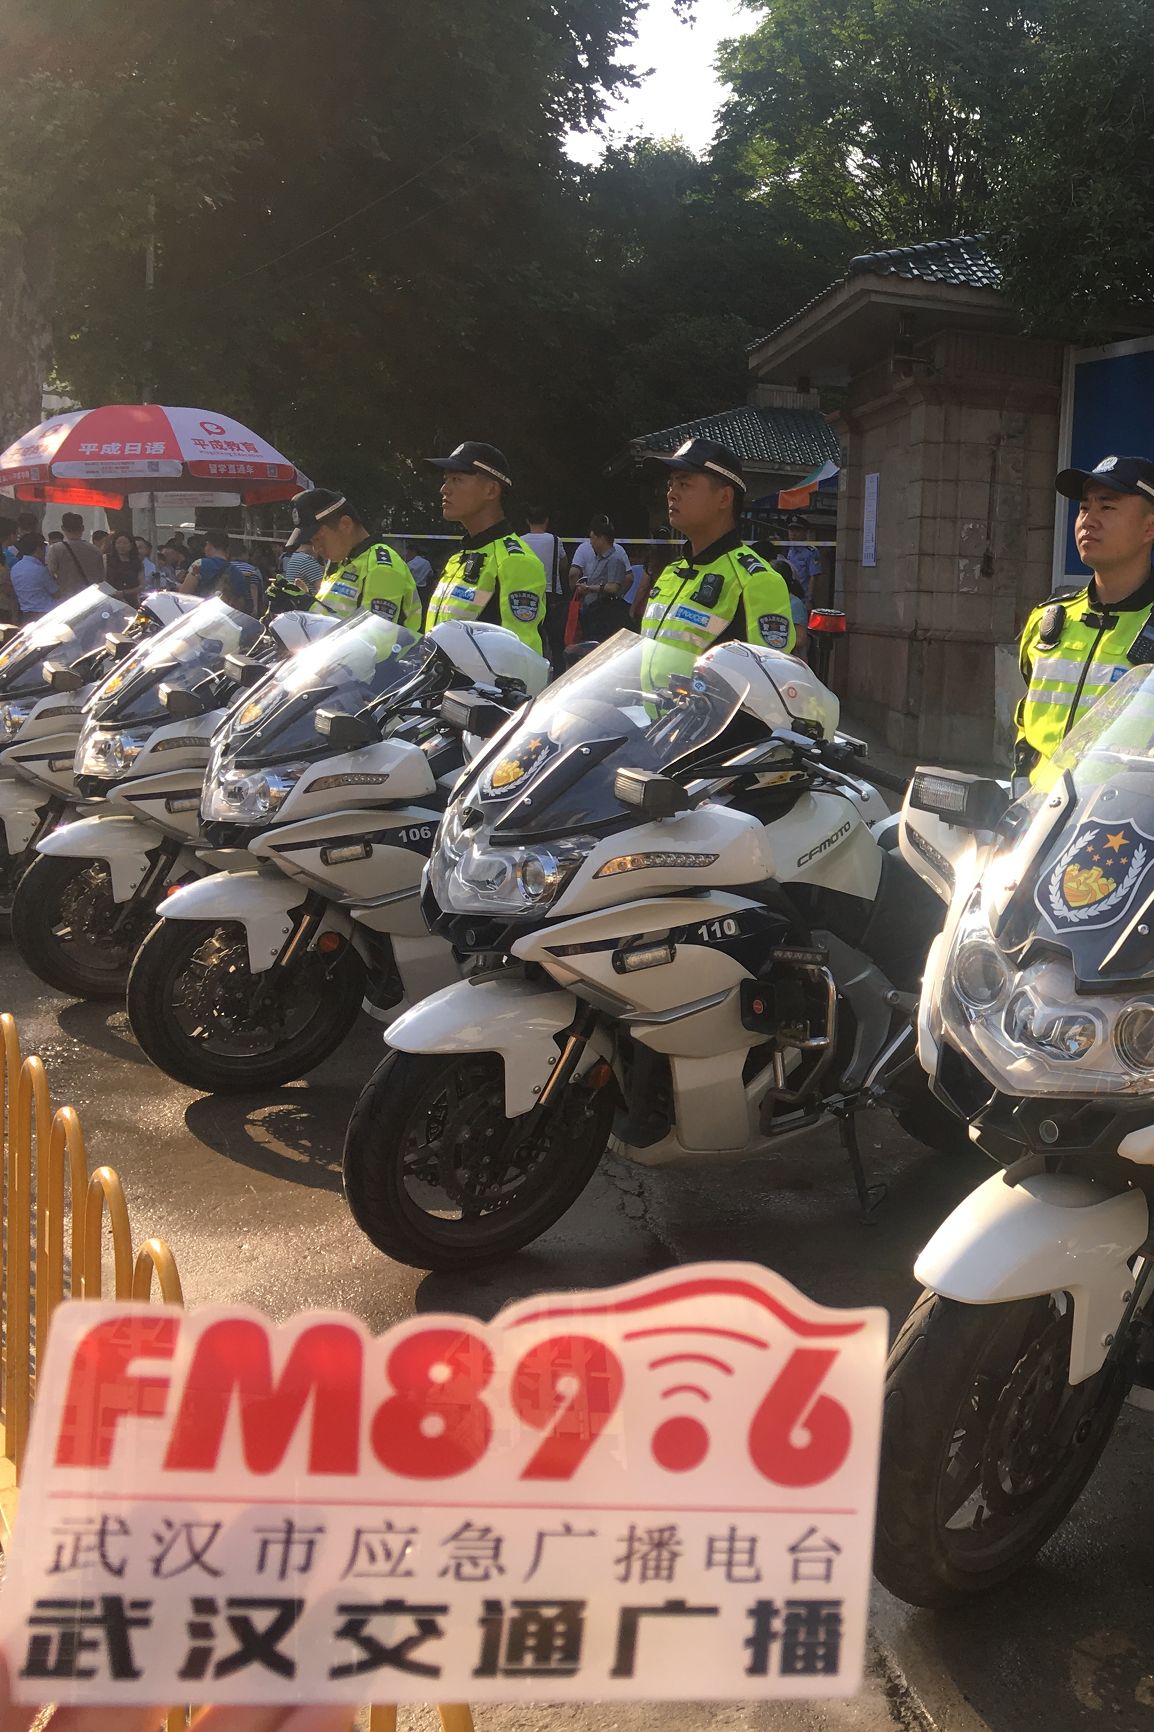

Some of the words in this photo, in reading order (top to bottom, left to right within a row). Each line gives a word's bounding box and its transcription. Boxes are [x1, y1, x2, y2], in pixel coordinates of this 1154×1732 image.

[78, 441, 166, 455] 平成日语
[191, 438, 258, 453] 平成教育
[398, 826, 431, 842] 106
[797, 821, 851, 868] CFMOTO
[698, 919, 736, 941] 110
[54, 1315, 854, 1490] FM89.6
[45, 1516, 844, 1586] 武汉市应急广播电台
[18, 1593, 844, 1682] 武汉交通广播
